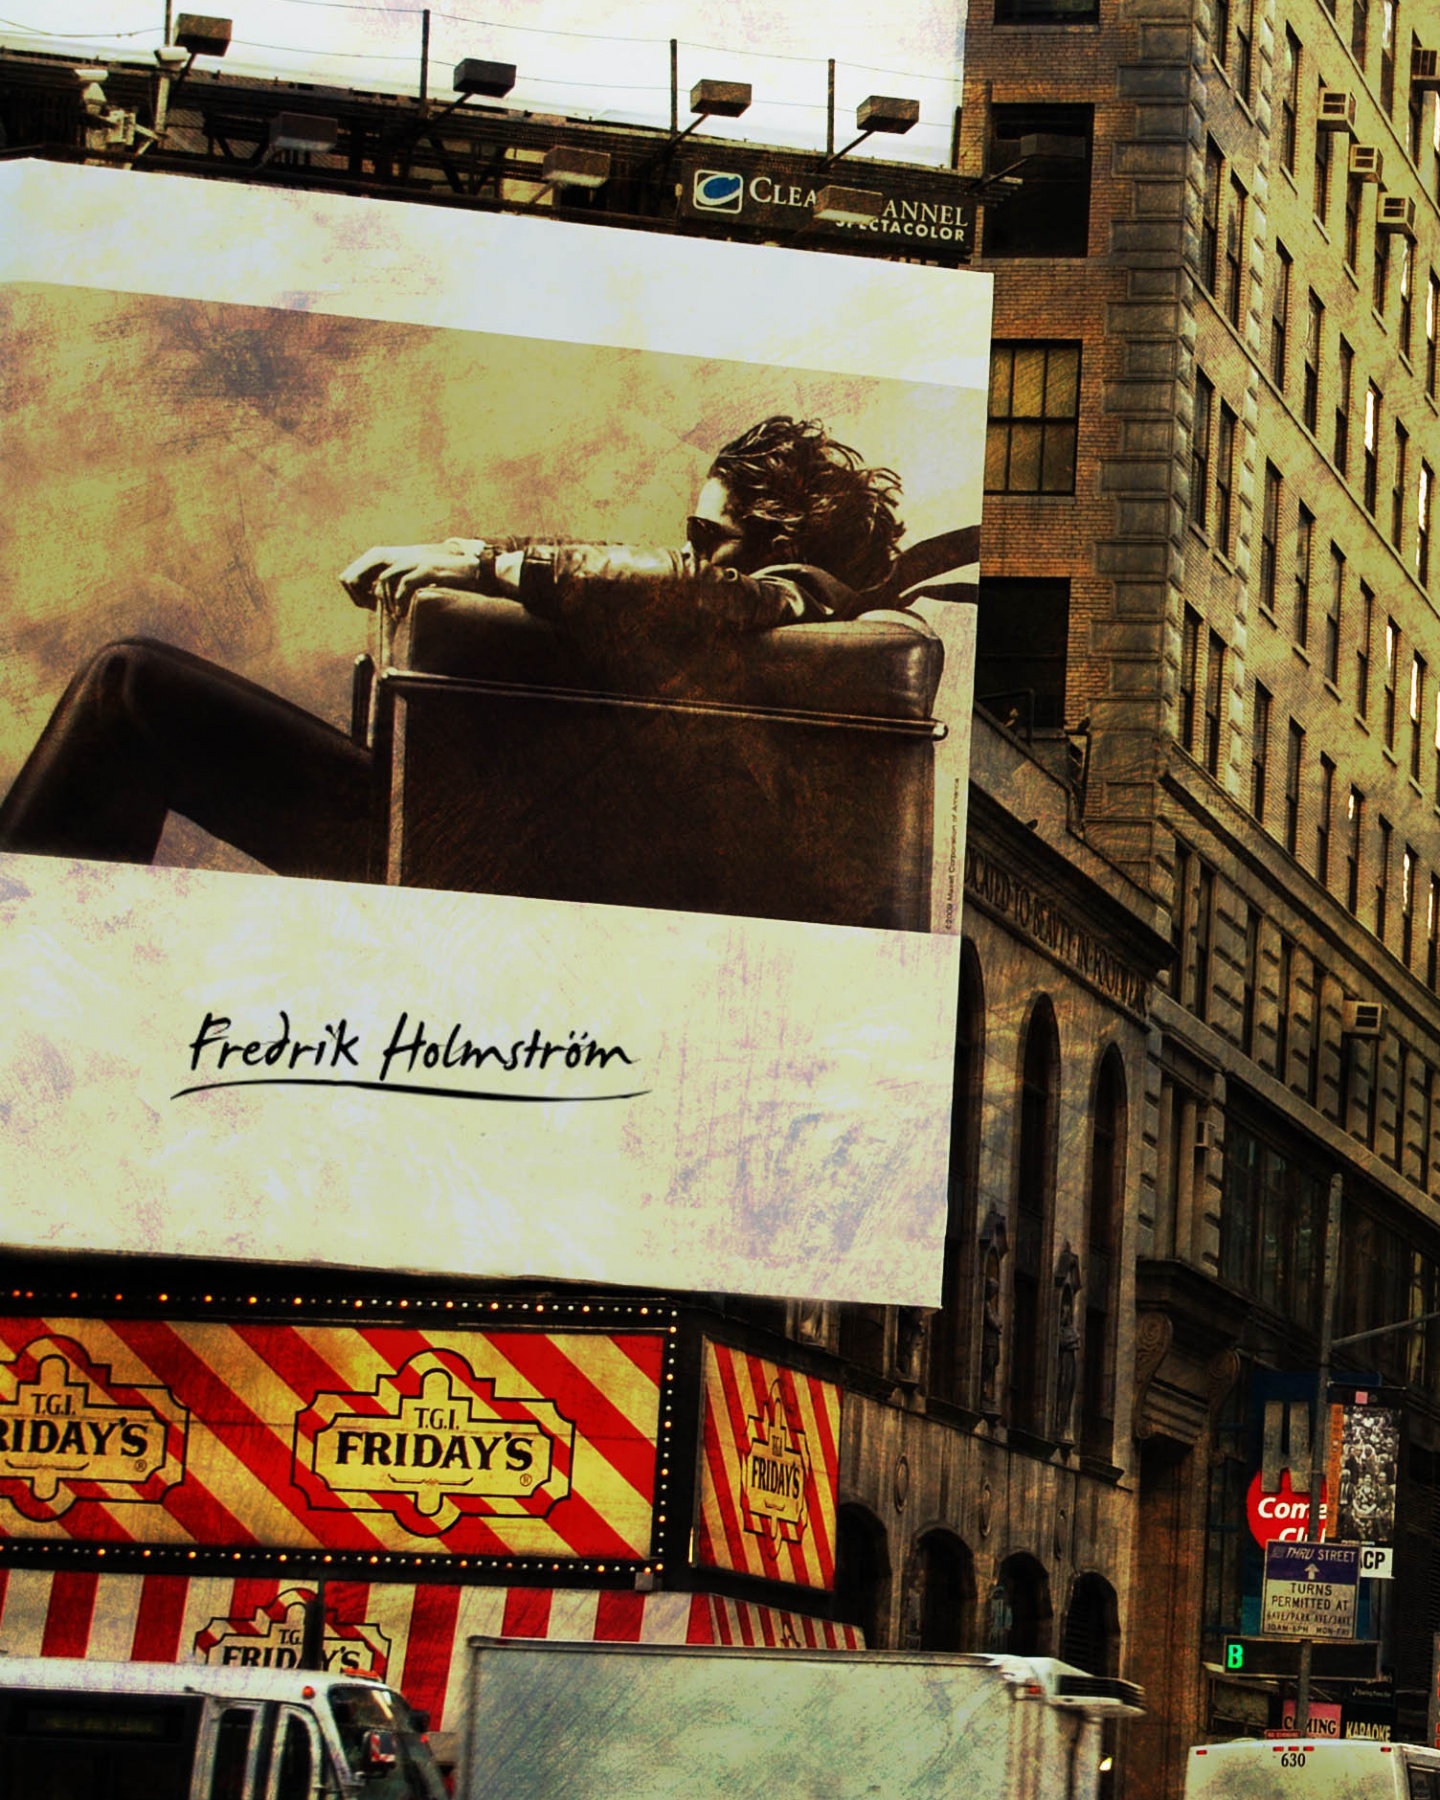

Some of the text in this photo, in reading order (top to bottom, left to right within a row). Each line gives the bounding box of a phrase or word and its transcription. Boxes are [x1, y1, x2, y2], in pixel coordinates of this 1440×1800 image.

[750, 177, 969, 229] CLEA ANNEL
[189, 1011, 640, 1081] Fredrik Holmström
[30, 1392, 76, 1416] T.G.I.
[413, 1407, 459, 1430] T.G.I.
[335, 1431, 534, 1472] FRIDAY'S
[751, 1455, 800, 1500] FRIDAY'S
[1317, 1548, 1357, 1563] STREET
[1291, 1582, 1333, 1597] TURNS
[1271, 1595, 1348, 1611] PERMITTED AT
[222, 1645, 361, 1674] FRIDY'S
[1346, 1721, 1392, 1742] KARAOKE
[1280, 1752, 1306, 1768] 630
